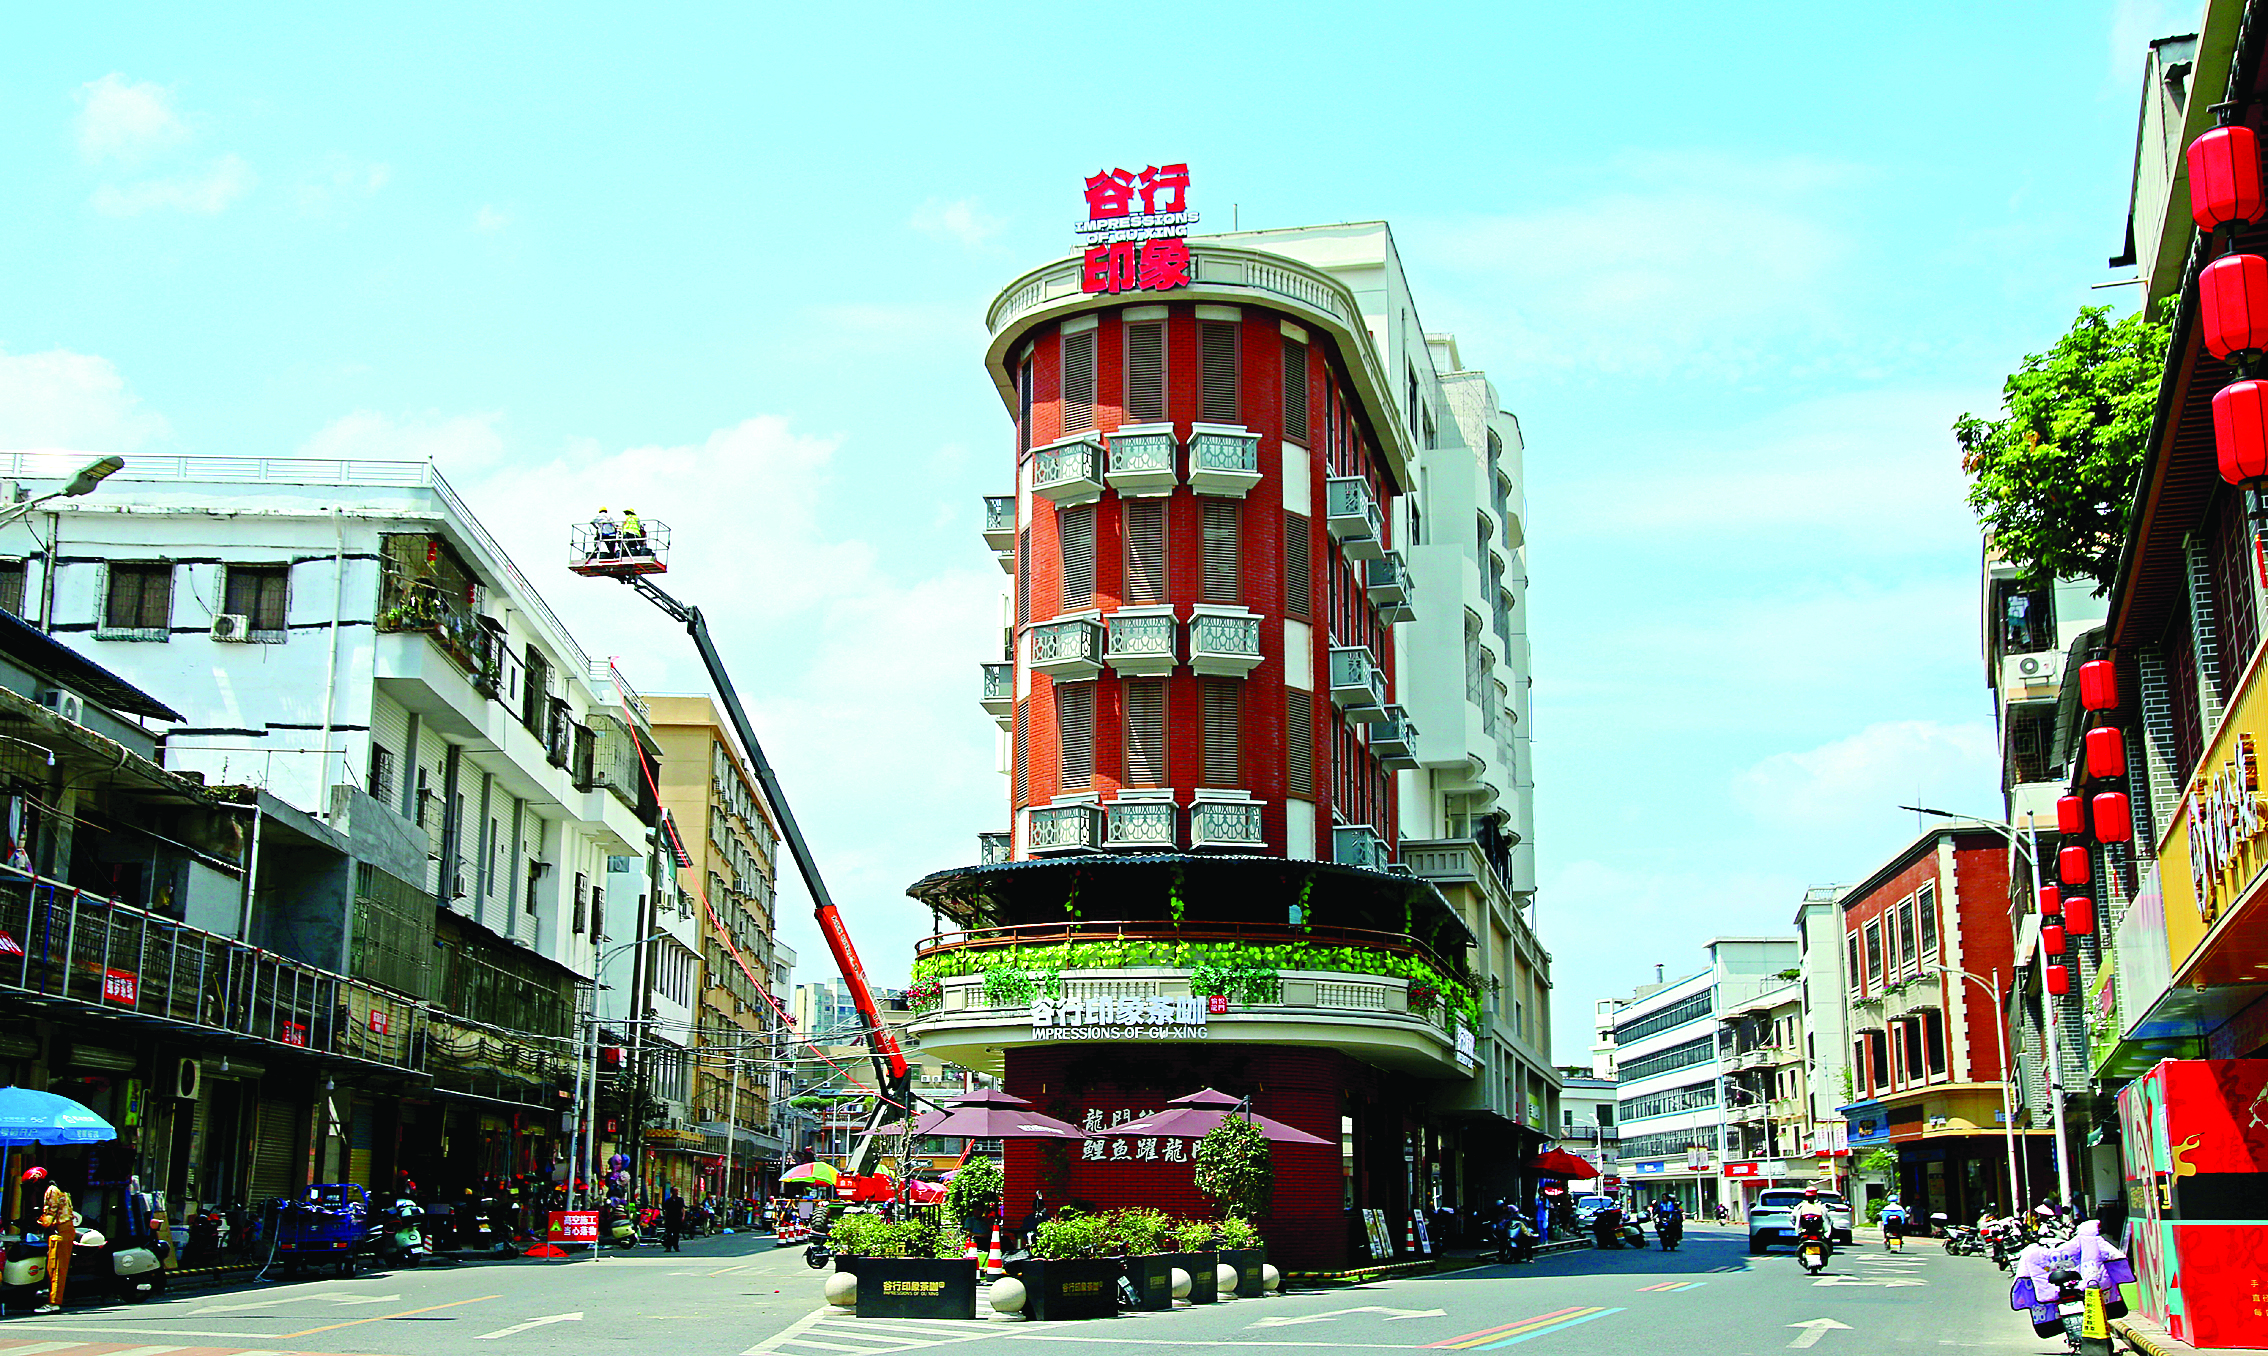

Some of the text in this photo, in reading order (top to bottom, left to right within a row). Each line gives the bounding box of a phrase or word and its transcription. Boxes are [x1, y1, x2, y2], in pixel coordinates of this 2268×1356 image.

[1084, 163, 1190, 219] 谷行
[1075, 212, 1199, 233] IMPRESSIONS
[1086, 225, 1187, 245] OF GU XING
[1082, 238, 1191, 294] 印象
[1030, 995, 1206, 1027] 谷行印象茶咖
[1032, 1024, 1208, 1040] IMPRESSIONS OF GU XING
[564, 1215, 597, 1225] 高空施工
[564, 1226, 597, 1236] 当心落物
[883, 1281, 939, 1292] 谷行印象茶咖
